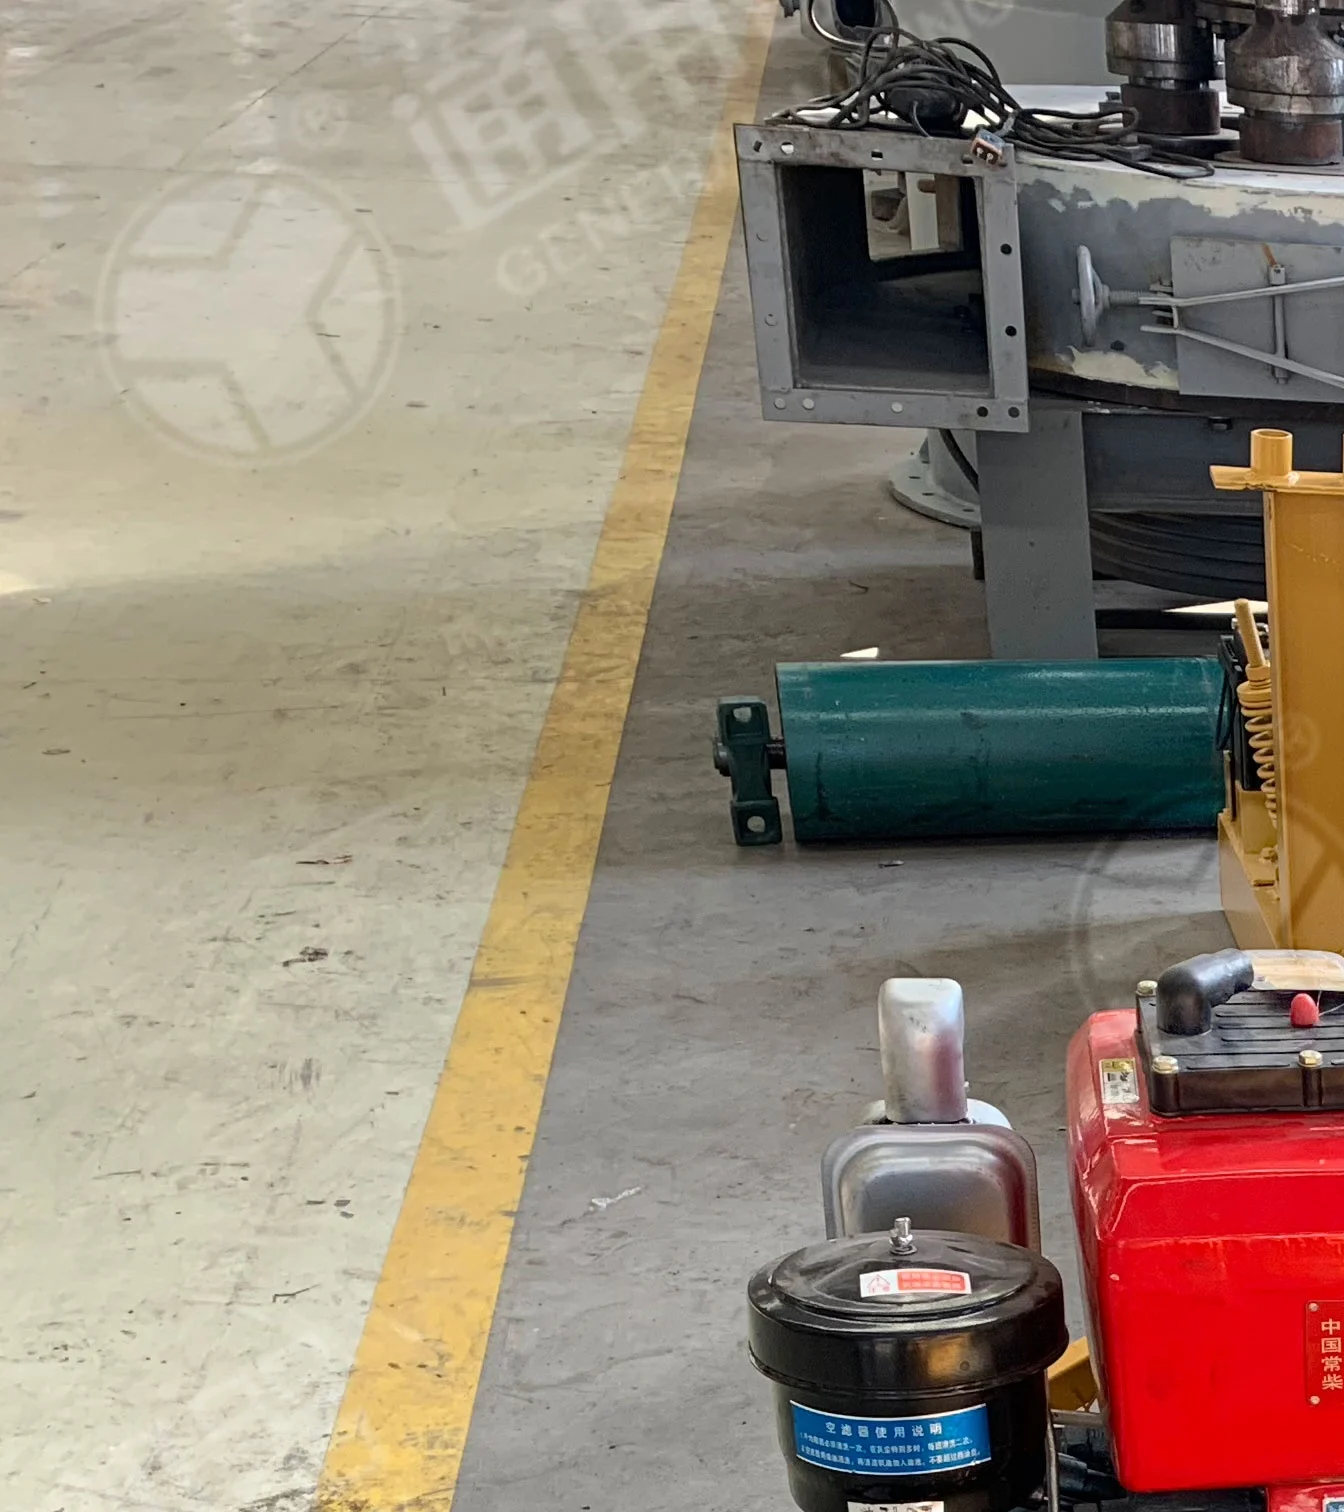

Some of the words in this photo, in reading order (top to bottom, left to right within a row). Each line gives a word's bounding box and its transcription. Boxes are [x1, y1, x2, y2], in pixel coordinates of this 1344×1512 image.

[1321, 1318, 1344, 1391] 中国常柴
[825, 1421, 943, 1439] 空滤器使用说明
